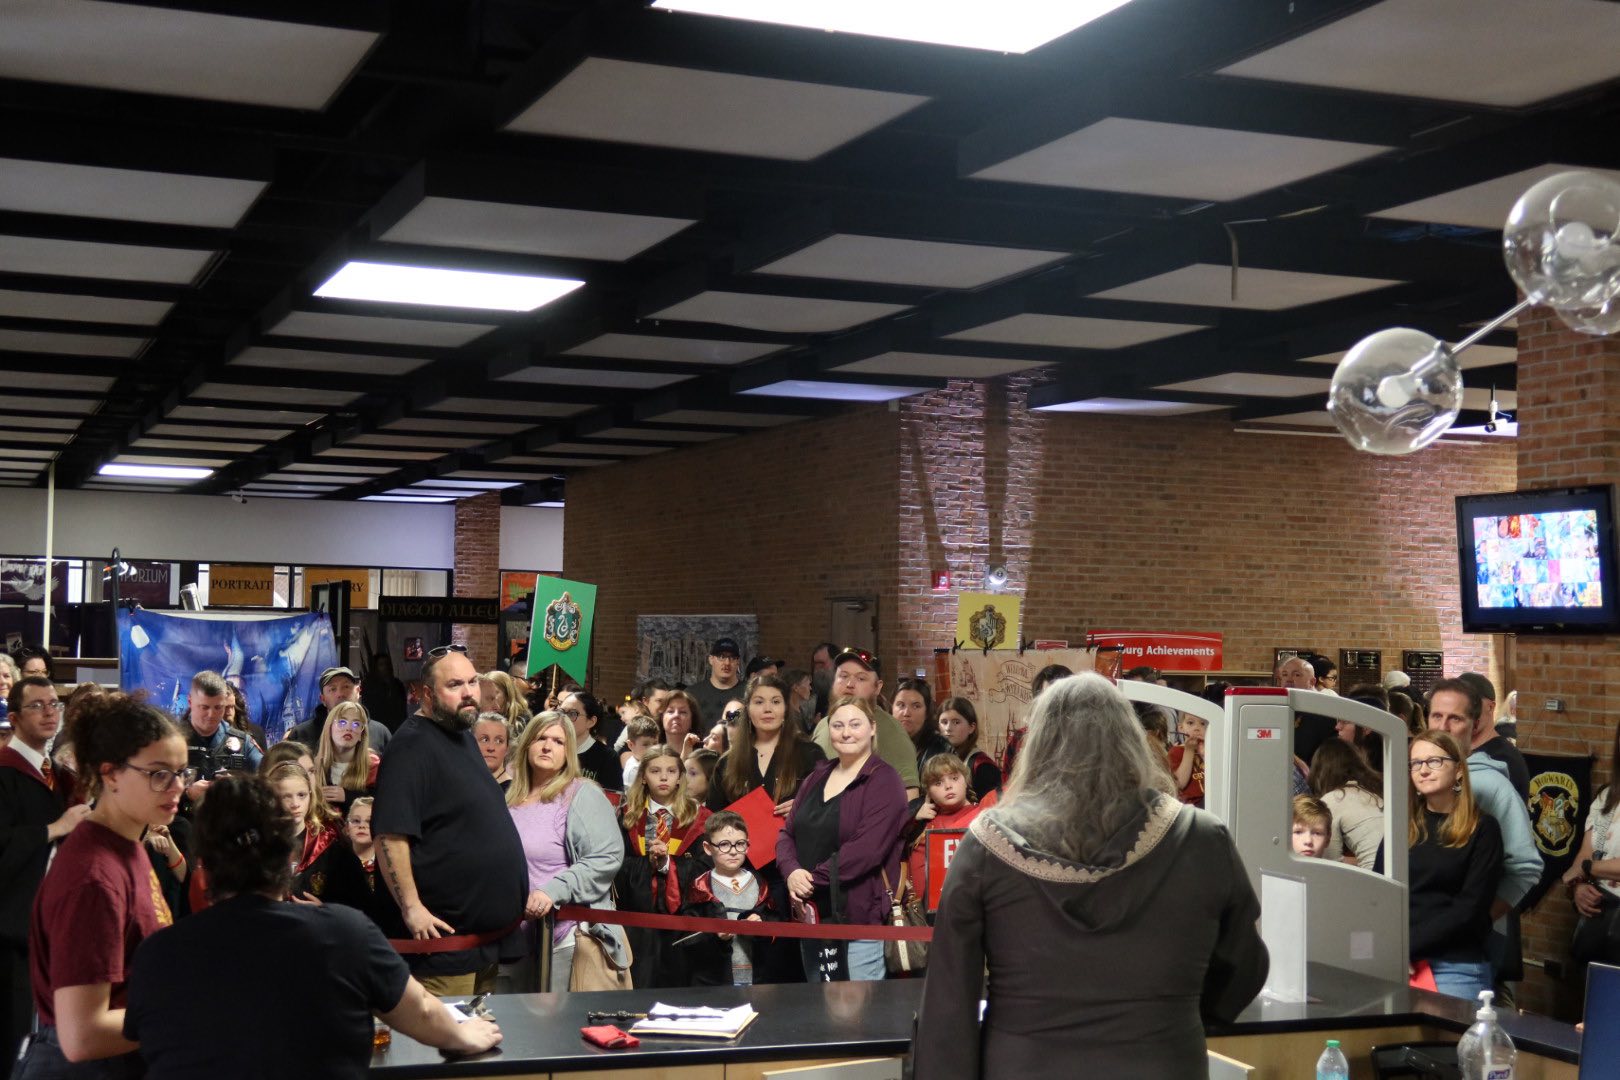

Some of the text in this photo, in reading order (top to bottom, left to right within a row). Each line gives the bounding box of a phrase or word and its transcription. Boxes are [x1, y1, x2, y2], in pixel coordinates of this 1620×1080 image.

[212, 580, 272, 590] PORTRAIT
[380, 603, 498, 619] DIAGON ALLEY
[1146, 645, 1215, 656] Achievements
[1256, 729, 1272, 739] 3M
